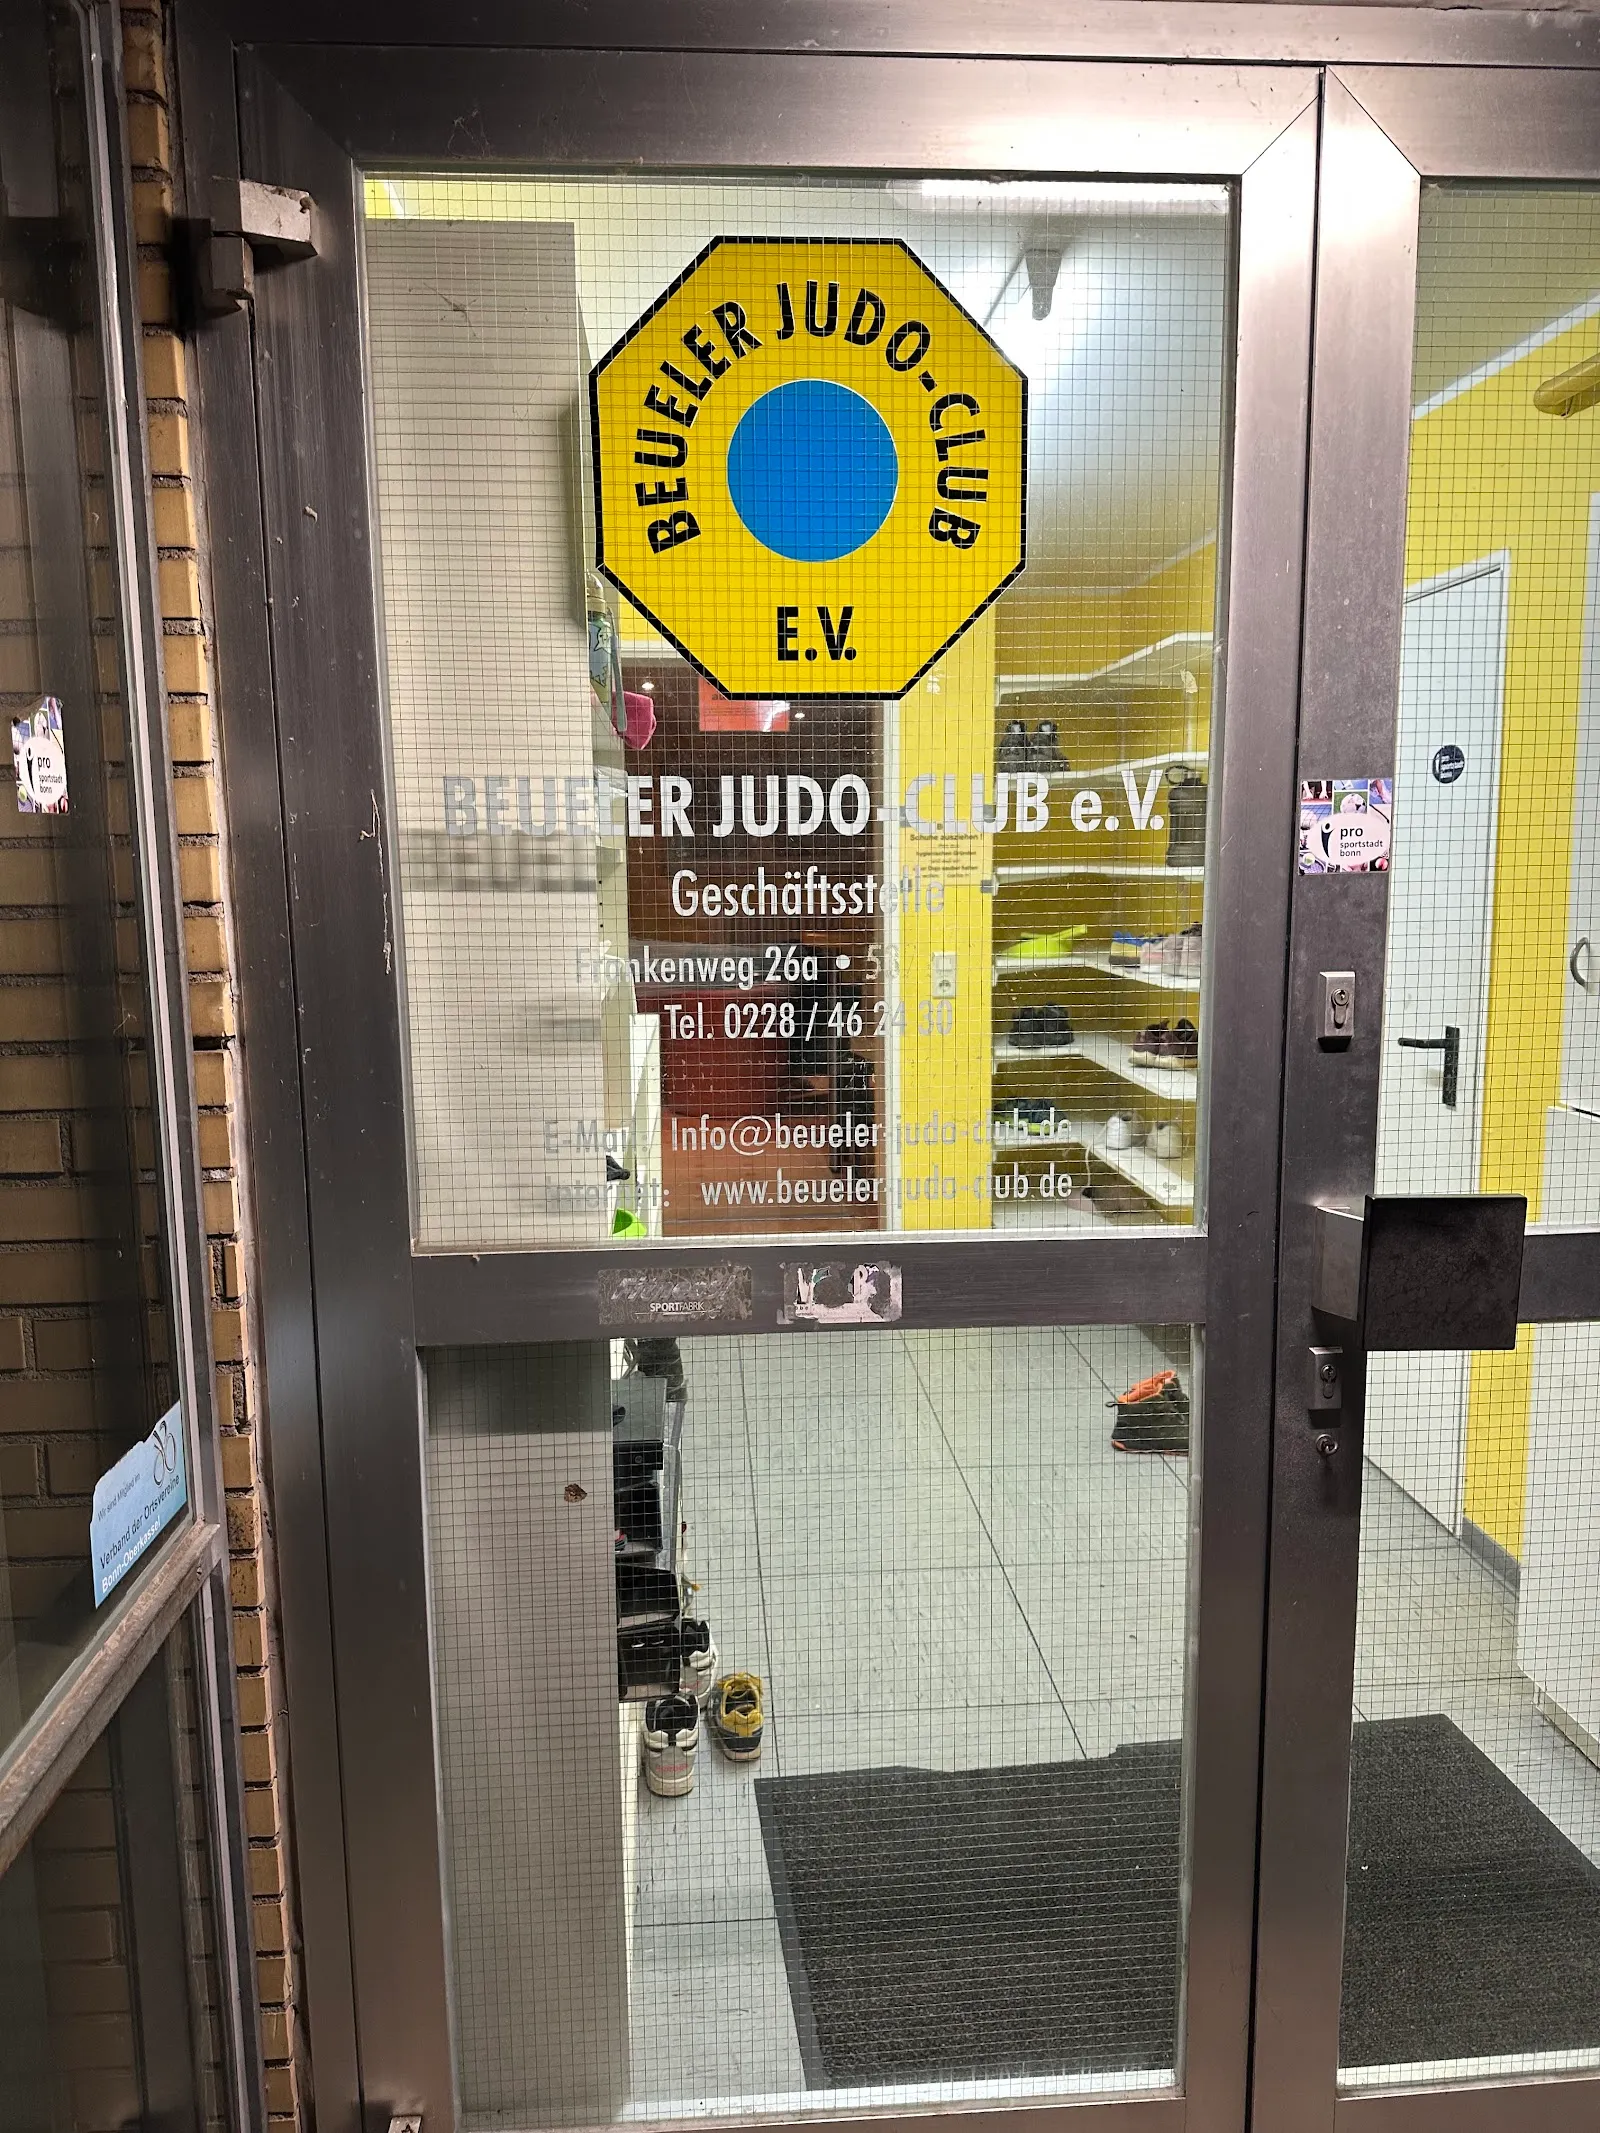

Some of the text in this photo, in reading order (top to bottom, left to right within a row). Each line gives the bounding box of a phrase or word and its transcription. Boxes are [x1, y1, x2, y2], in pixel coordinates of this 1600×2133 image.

[634, 279, 989, 554] BEUELER JUDO-CLUB
[777, 605, 857, 662] E.V.
[38, 757, 51, 771] pro
[443, 769, 1166, 838] BEUELER JUDO-CLUB e.V.
[1339, 839, 1383, 849] sportstadt
[1340, 827, 1364, 841] pro
[1340, 849, 1361, 857] bonn
[671, 865, 945, 917] Geschäftsstelle
[576, 945, 755, 991] Frankenweg
[764, 945, 818, 982] 26a
[663, 999, 954, 1042] Tel. 0228 / 46 24 30
[99, 1473, 181, 1571] Verband der Ortsvereine
[101, 1514, 162, 1594] Bonn-Oberkassel
